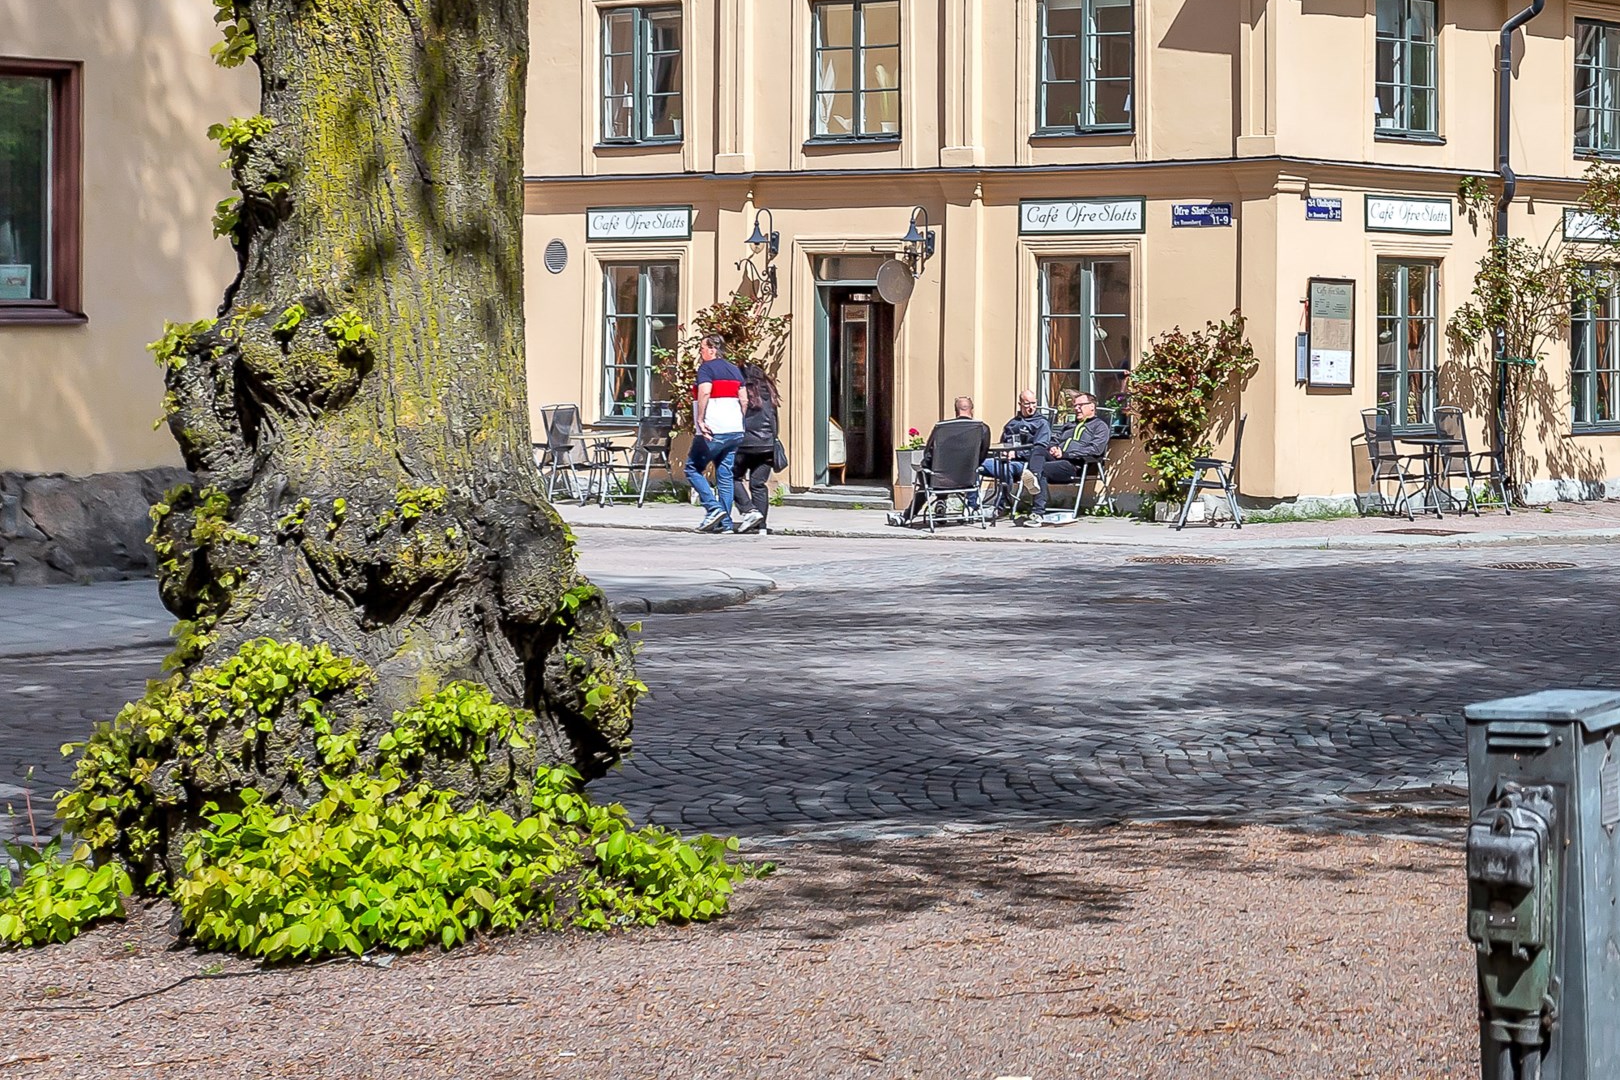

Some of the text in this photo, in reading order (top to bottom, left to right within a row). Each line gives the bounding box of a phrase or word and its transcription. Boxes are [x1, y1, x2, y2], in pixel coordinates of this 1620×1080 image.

[593, 210, 685, 235] Café Öfre Slotts
[1027, 202, 1137, 228] Café Öfre Slotts
[1371, 202, 1394, 223] Café
[1422, 204, 1447, 222] Slotts
